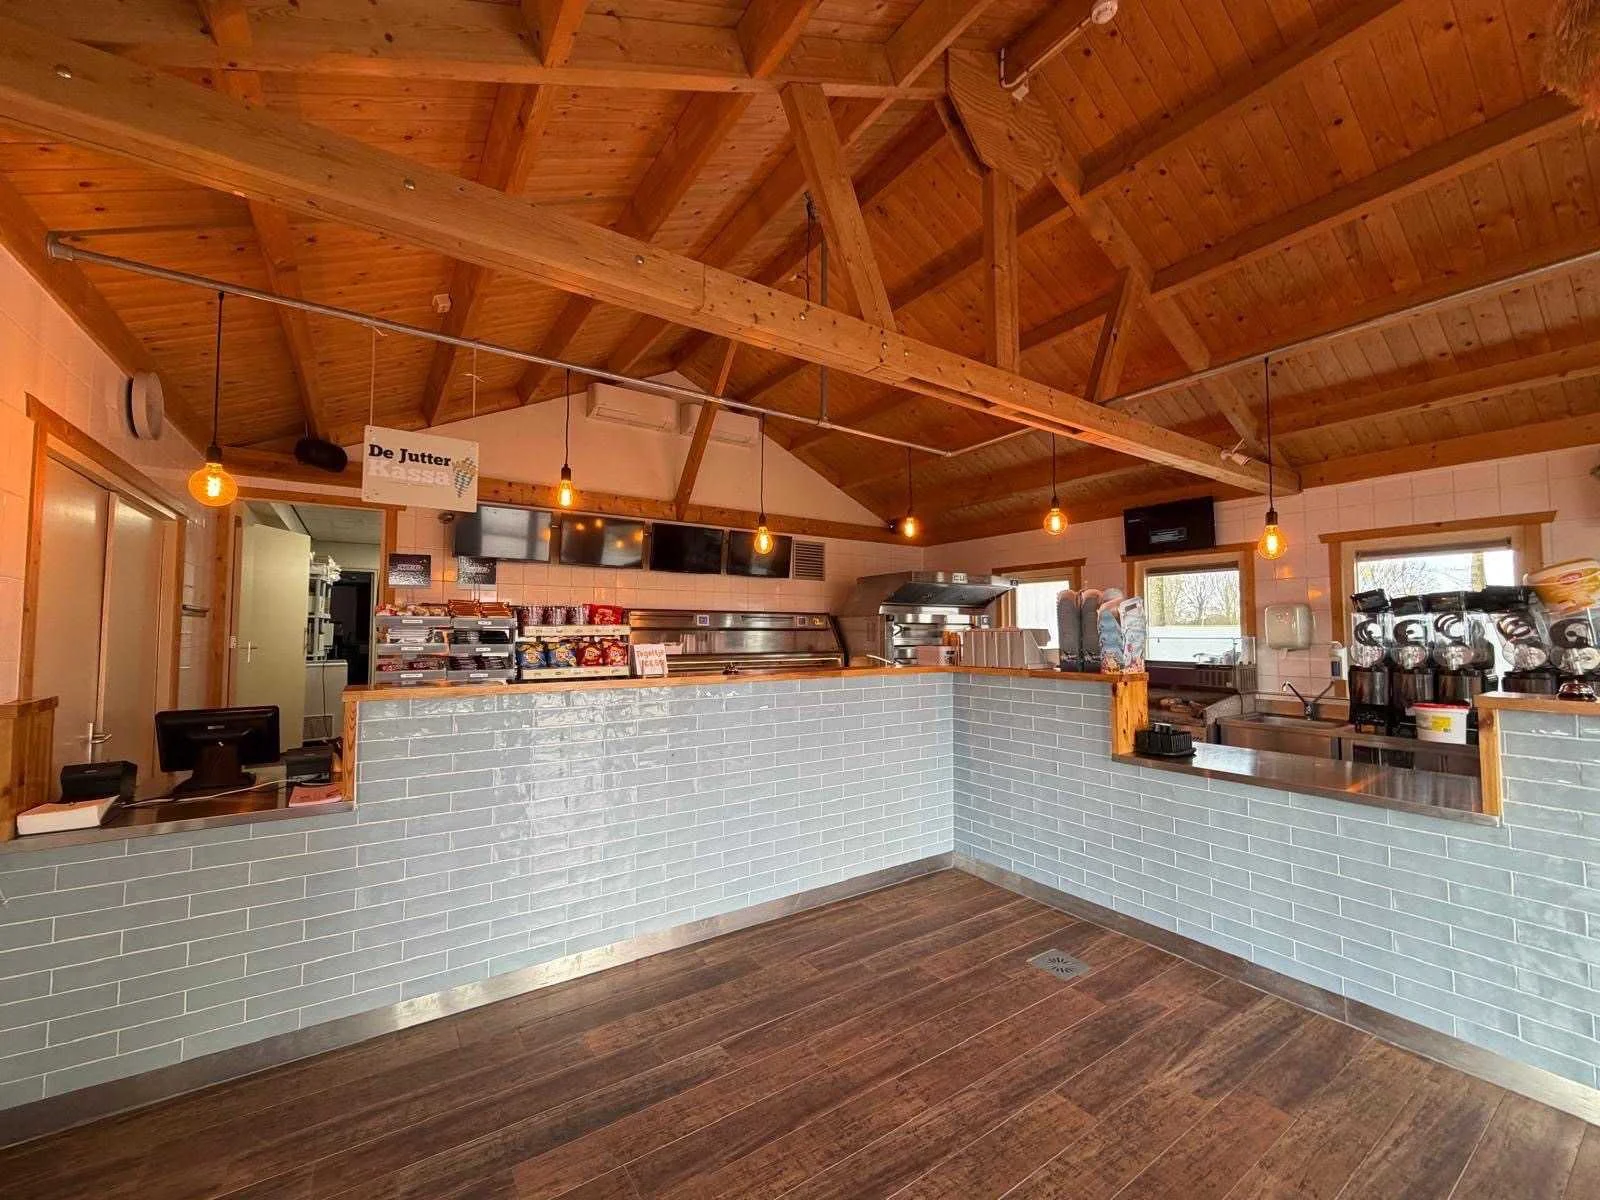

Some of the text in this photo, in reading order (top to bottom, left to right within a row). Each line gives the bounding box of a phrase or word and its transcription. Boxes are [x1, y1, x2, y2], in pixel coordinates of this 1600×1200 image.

[368, 443, 451, 466] De Jutter
[367, 460, 452, 485] Kassa
